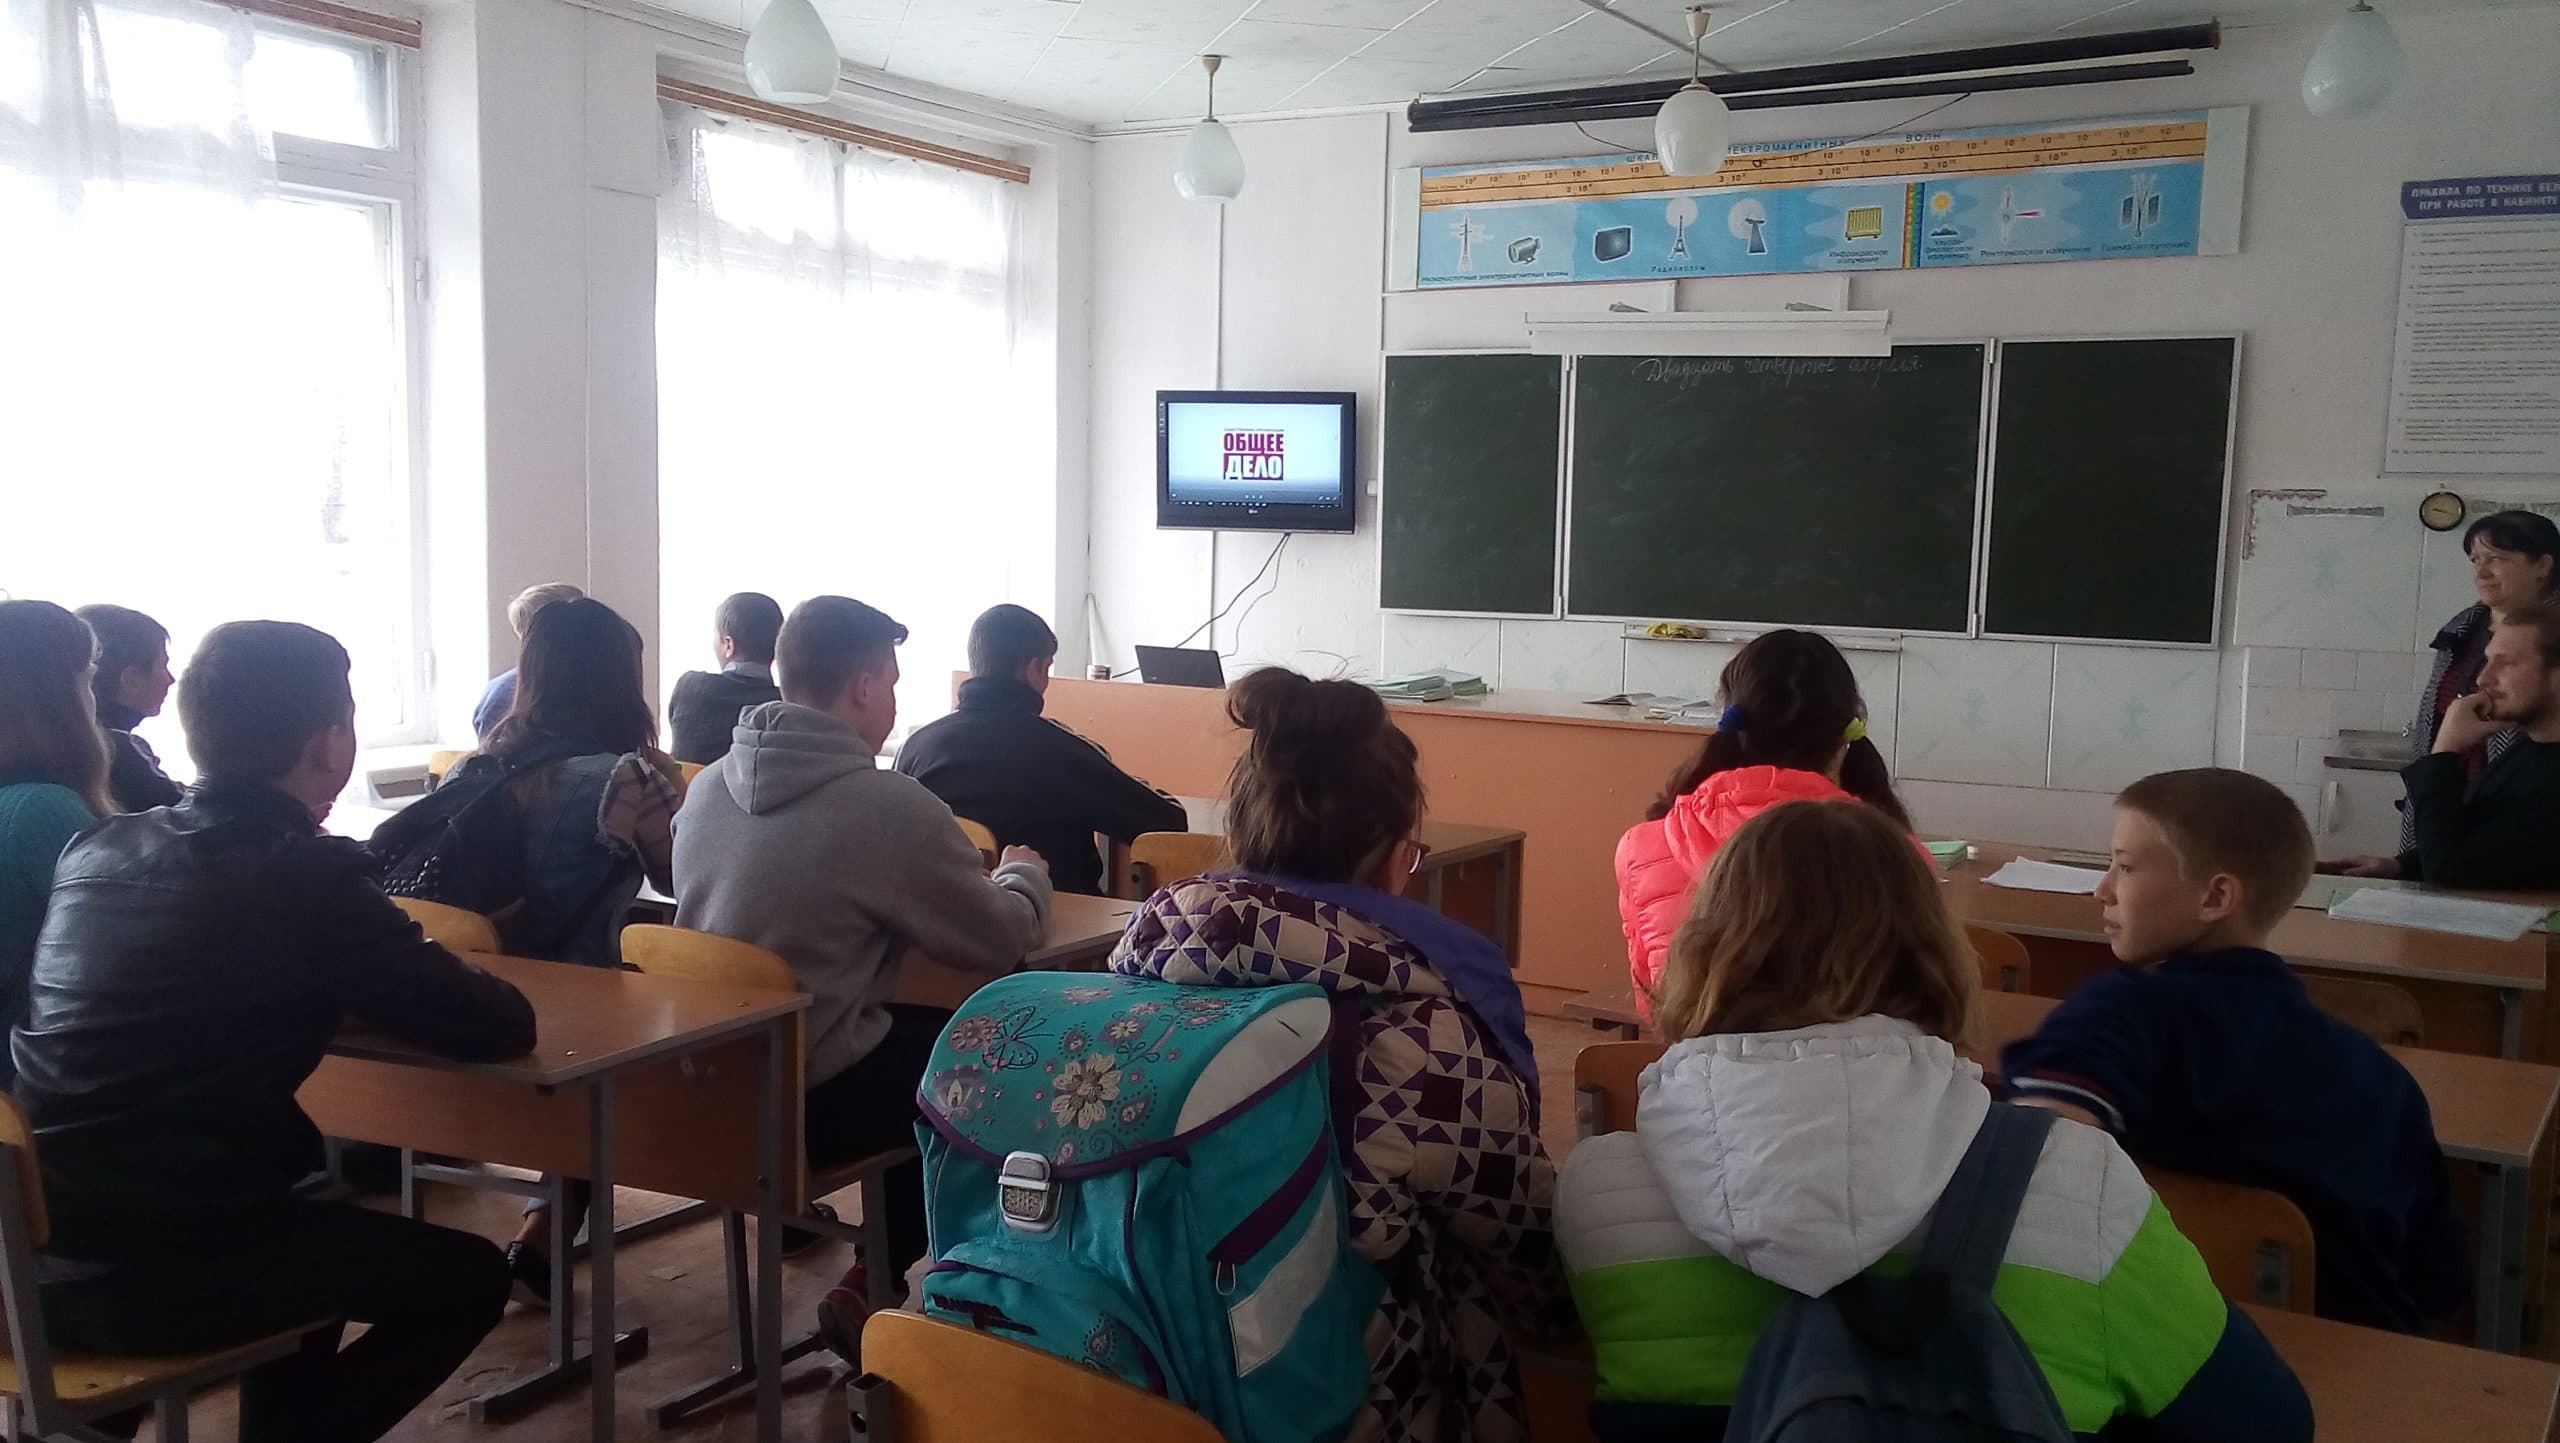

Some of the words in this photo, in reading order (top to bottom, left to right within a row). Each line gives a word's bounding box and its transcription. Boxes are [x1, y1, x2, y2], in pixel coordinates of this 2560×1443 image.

[1728, 139, 1848, 155] ЕКТРОМАГНИТНЫХ
[1223, 432, 1284, 454] ОБЩЕЕ
[1225, 455, 1282, 479] ДЕЛО
